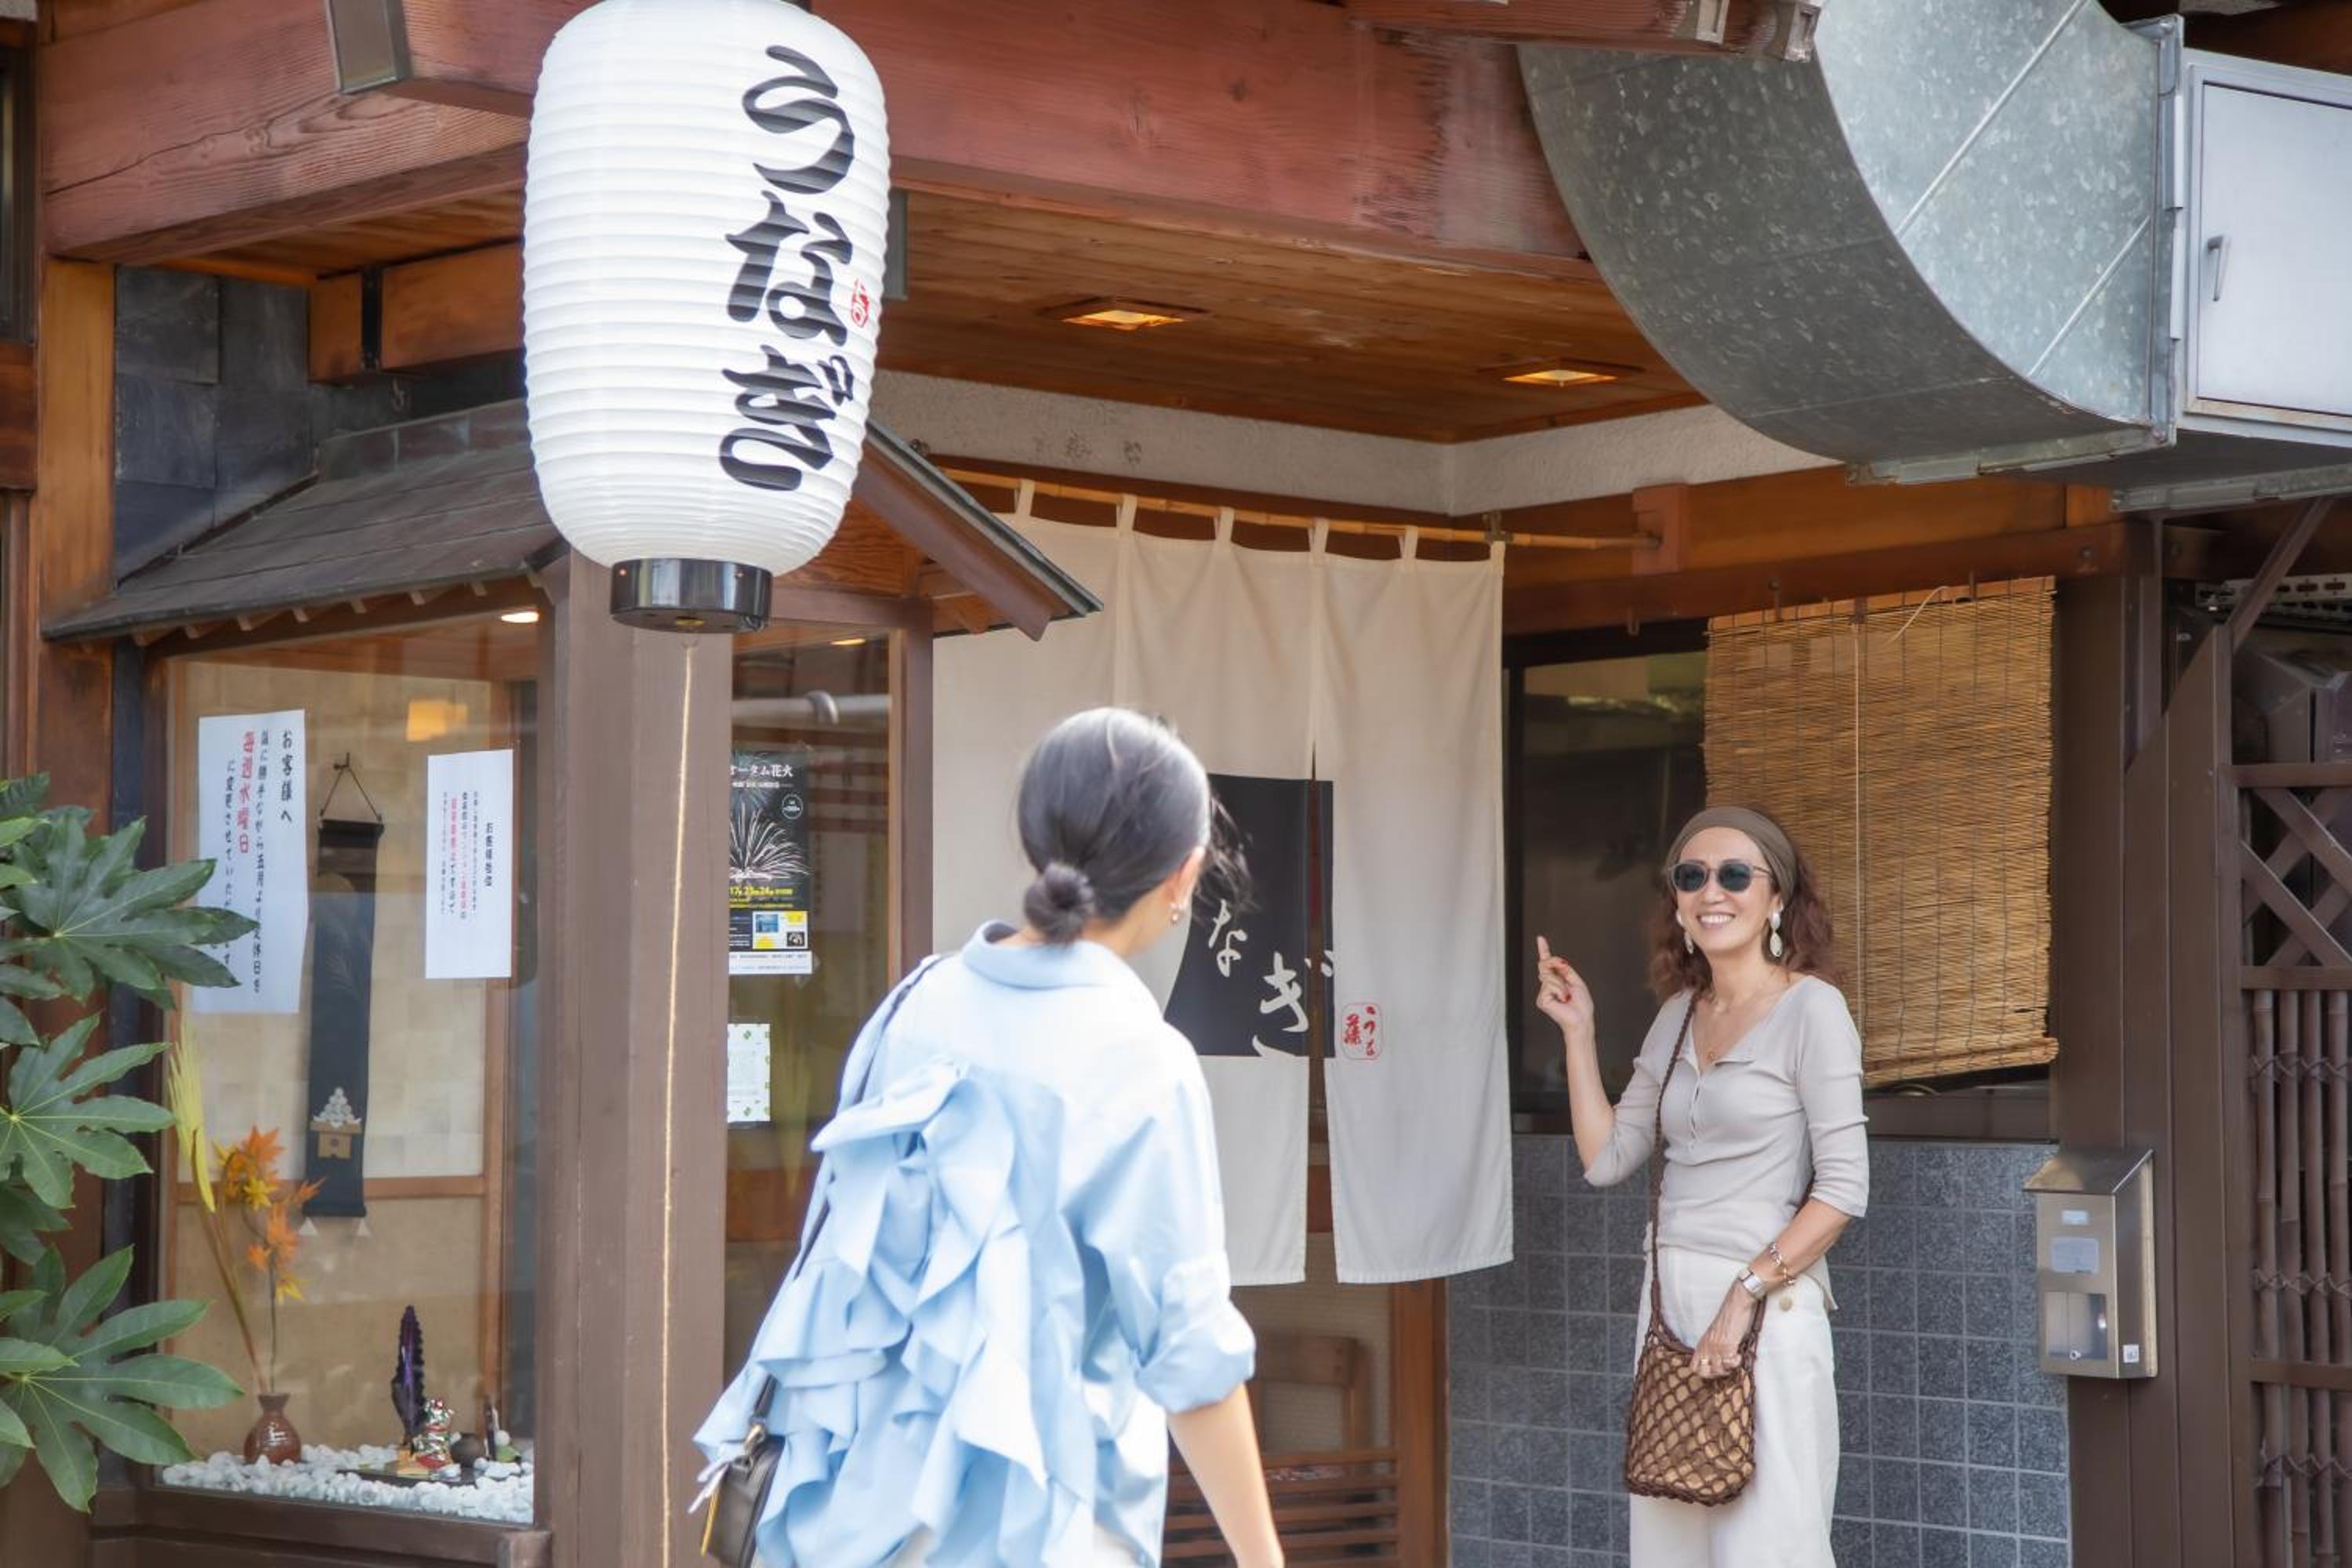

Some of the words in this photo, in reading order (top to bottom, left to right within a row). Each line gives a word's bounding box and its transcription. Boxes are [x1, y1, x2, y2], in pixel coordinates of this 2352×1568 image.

[719, 45, 855, 492] うなぎ
[238, 731, 255, 854] 毎週火曜日
[281, 729, 292, 824] お客様へ
